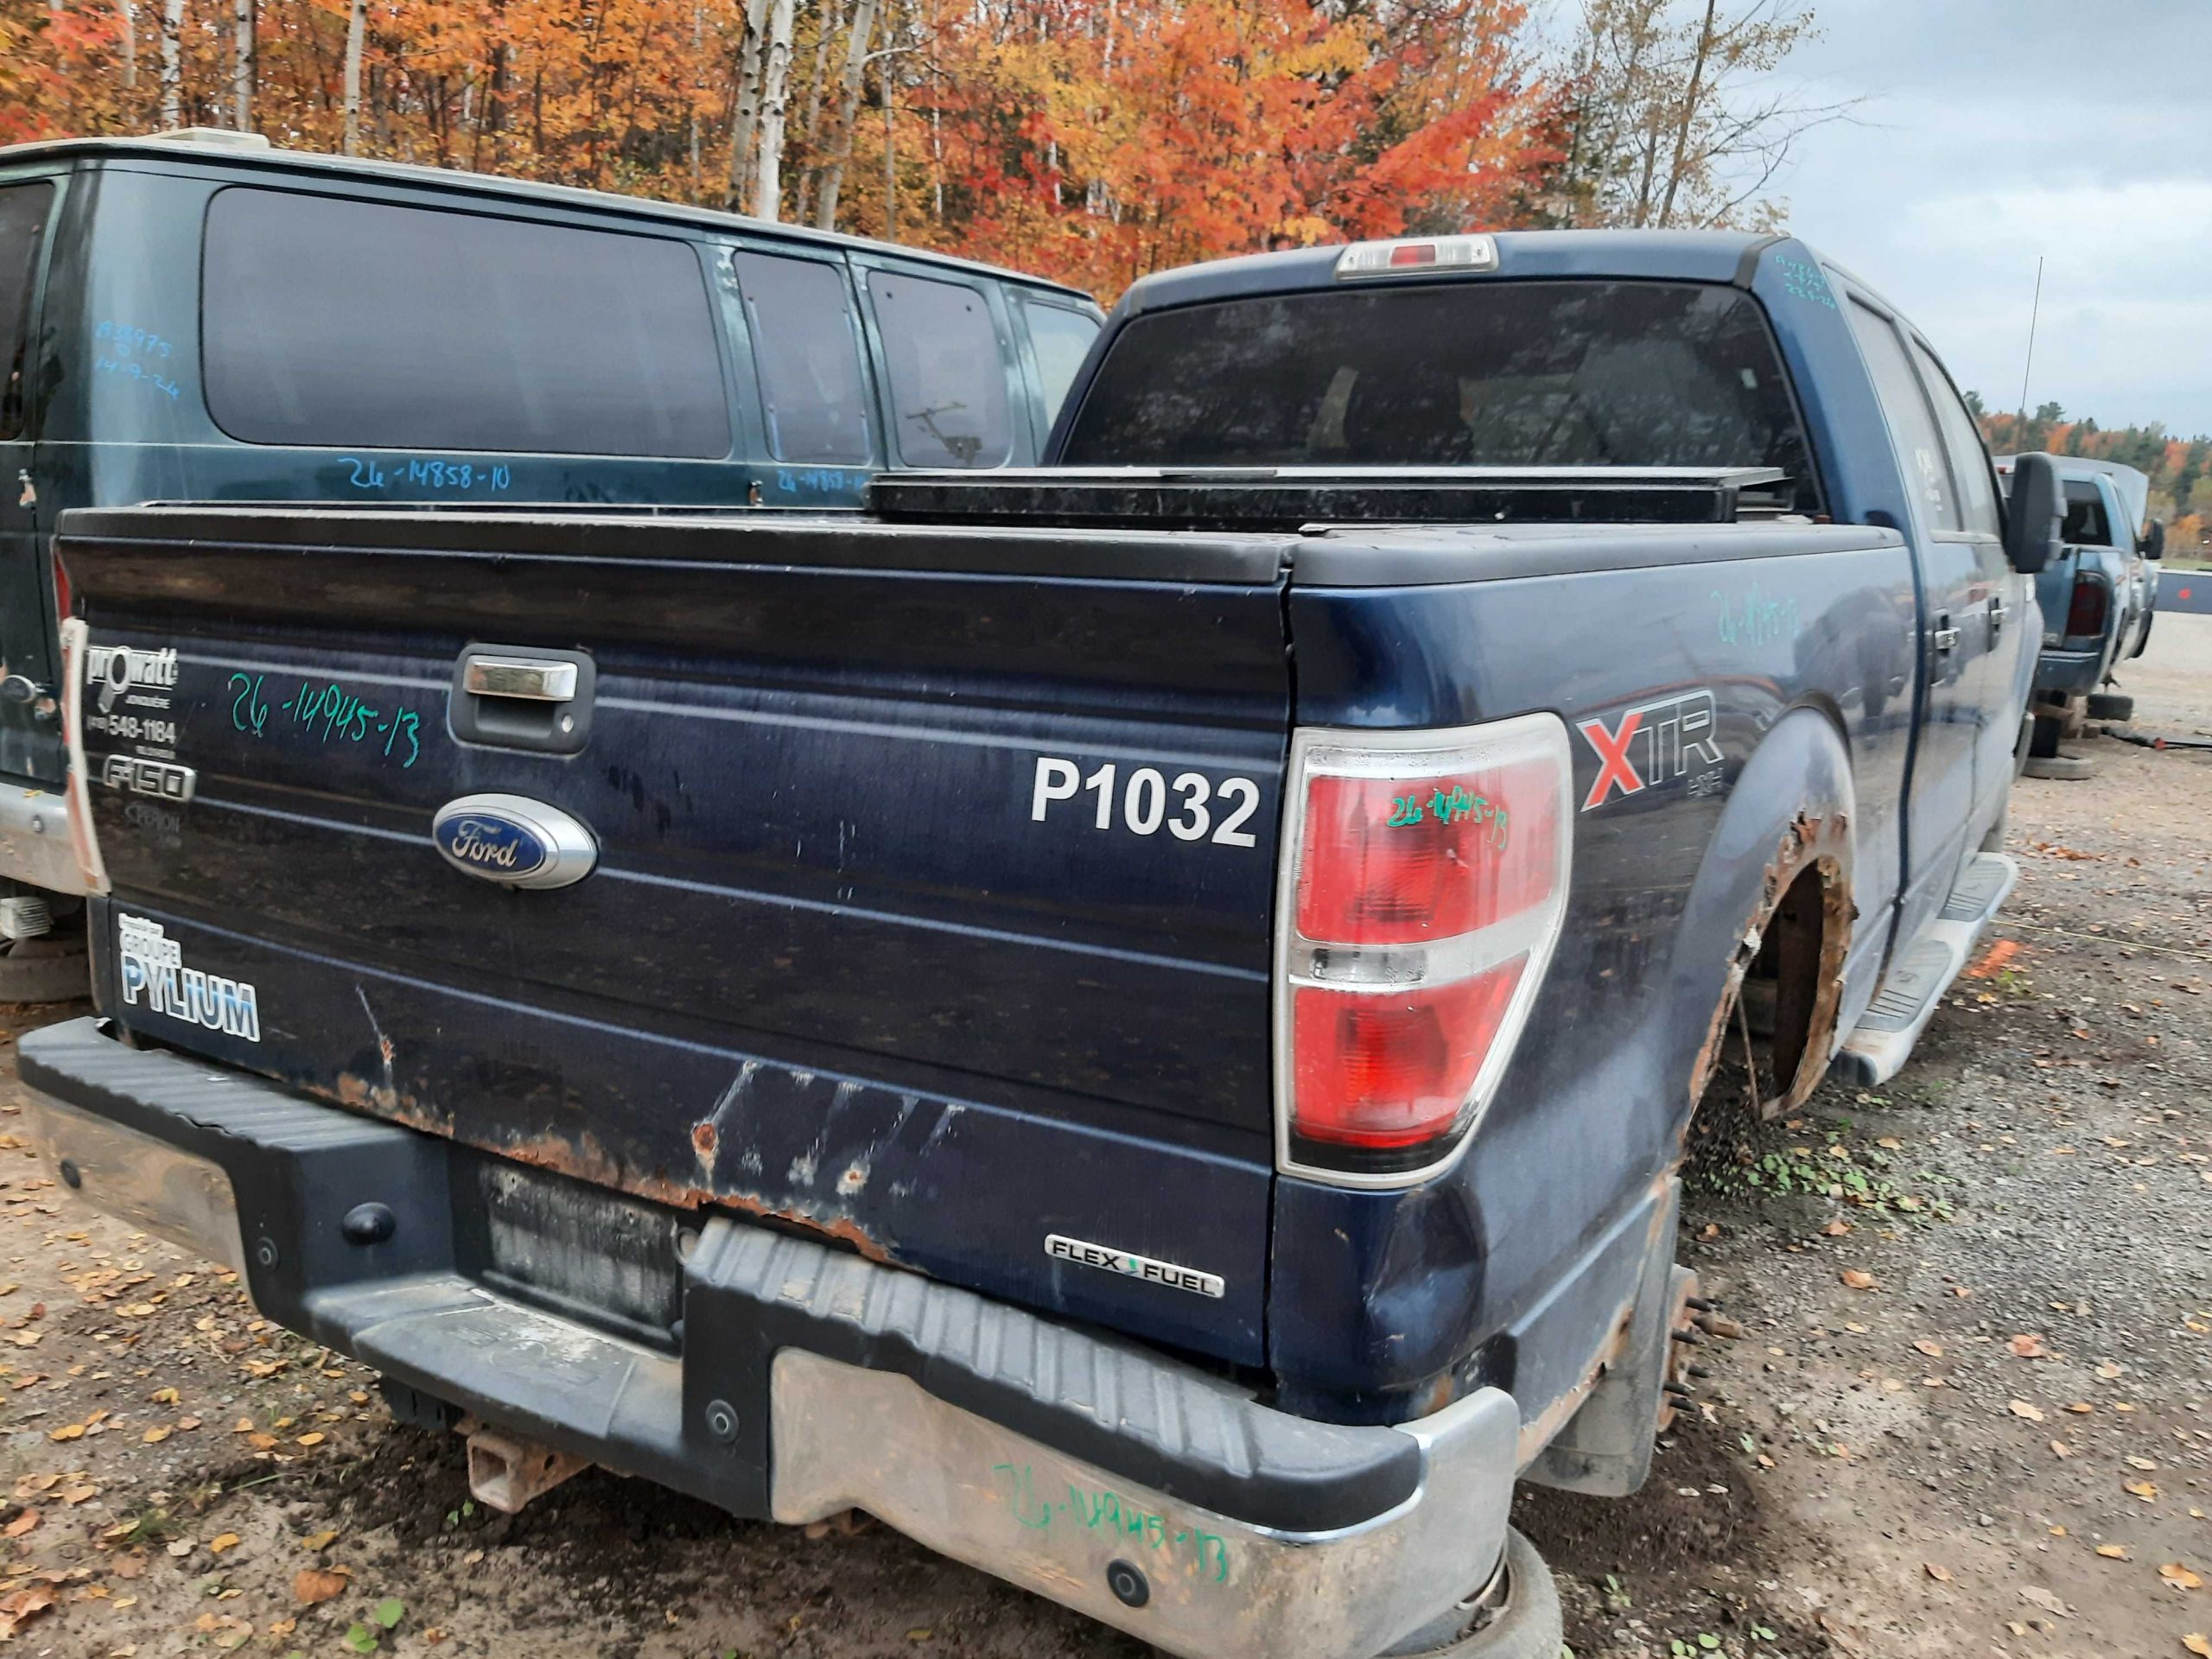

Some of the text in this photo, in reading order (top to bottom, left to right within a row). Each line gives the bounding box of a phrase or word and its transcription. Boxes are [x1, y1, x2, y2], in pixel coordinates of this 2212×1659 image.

[337, 457, 511, 492] 26-14858-10
[109, 715, 176, 744] 548-1184
[227, 672, 421, 769] 26-14945-13
[1575, 688, 1726, 813] XTR
[1032, 757, 1260, 848] P1032
[452, 820, 518, 868] Ford
[122, 952, 260, 1042] PYLIUM
[1052, 1240, 1216, 1295] FLEX FUEL
